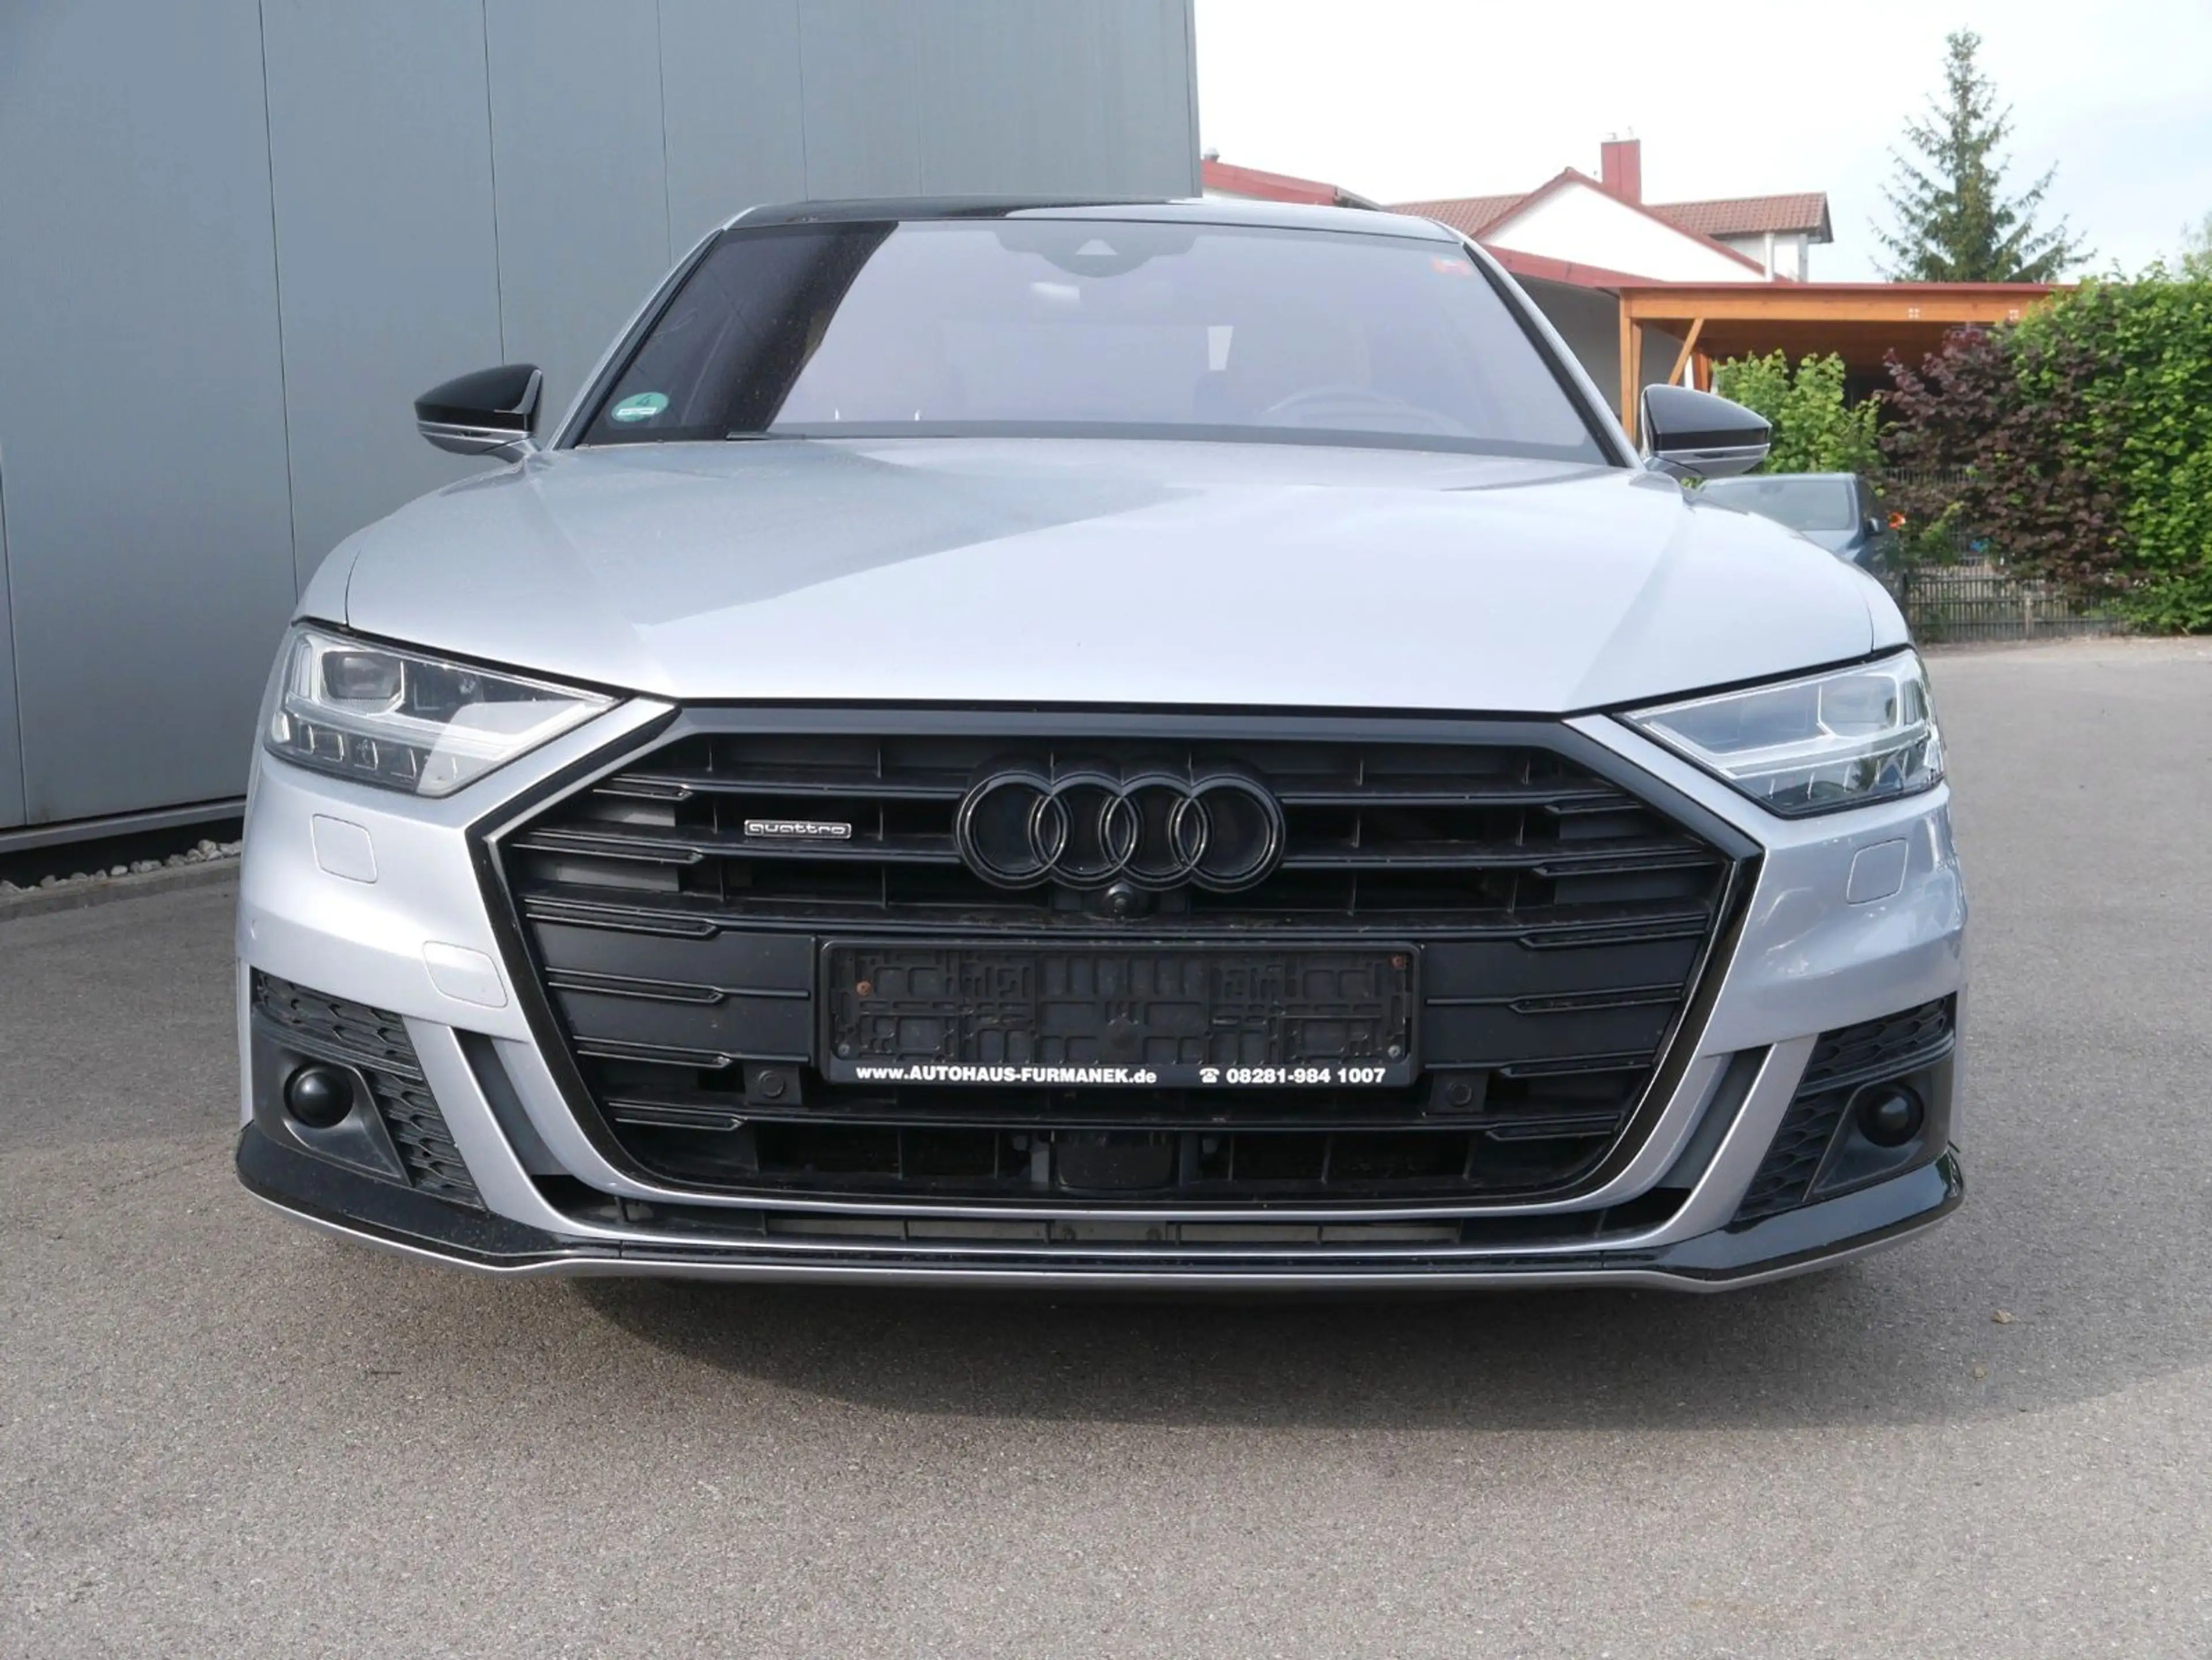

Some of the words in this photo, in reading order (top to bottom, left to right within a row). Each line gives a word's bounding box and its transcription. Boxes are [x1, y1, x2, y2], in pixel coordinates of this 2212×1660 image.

[749, 824, 846, 835] quattro
[856, 1066, 1156, 1084] www.AUTOHAUS-FURMANEK.de
[1226, 1068, 1331, 1084] 08281-984
[1337, 1068, 1386, 1083] 1007
